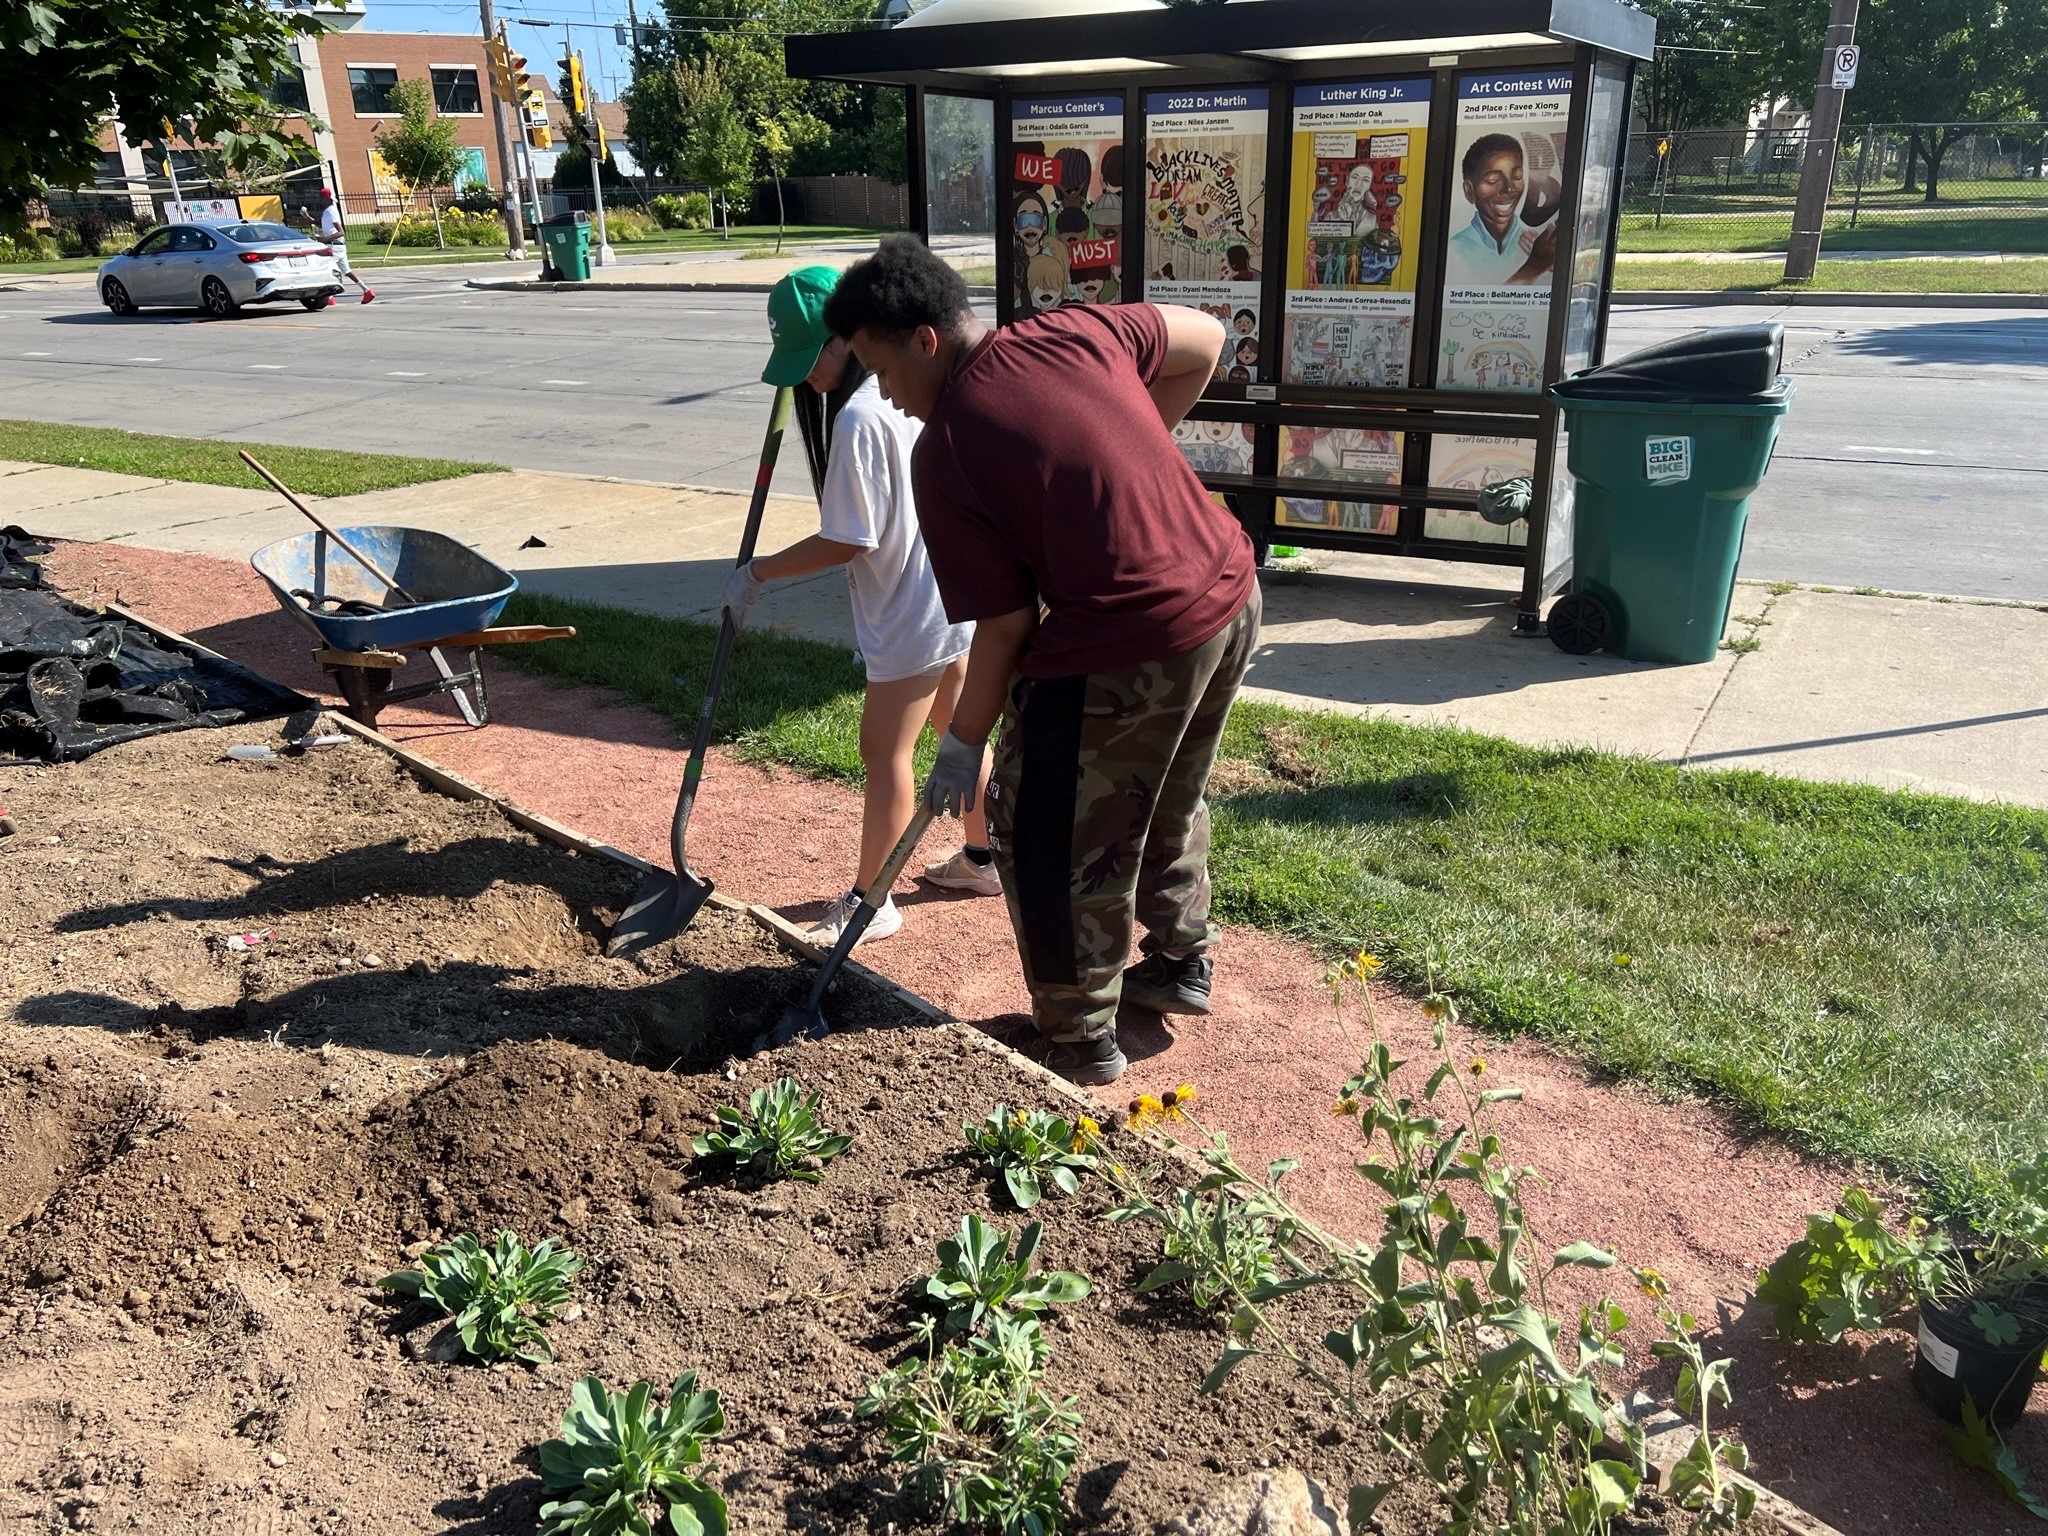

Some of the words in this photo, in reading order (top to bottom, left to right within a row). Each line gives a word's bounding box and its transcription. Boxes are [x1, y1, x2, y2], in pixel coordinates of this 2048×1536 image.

[1470, 82, 1490, 93] Art
[1494, 80, 1542, 92] Contest
[1547, 78, 1572, 89] Win
[1320, 89, 1357, 100] Luther
[1360, 88, 1386, 99] King
[1390, 87, 1403, 98] Jr.
[1031, 104, 1062, 114] Marcus
[1065, 102, 1104, 112] Center's
[1168, 98, 1194, 109] 2022
[1197, 98, 1210, 107] Dr.
[1214, 96, 1247, 106] Martin
[1535, 102, 1559, 110] Xiong
[1021, 158, 1054, 180] WE
[1166, 231, 1195, 246] IMAGINE
[1072, 240, 1116, 265] MUST
[1354, 297, 1411, 305] Correa-Resendiz
[1649, 440, 1683, 455] BIG
[1649, 454, 1683, 463] CLEAN
[1650, 462, 1683, 474] MKE
